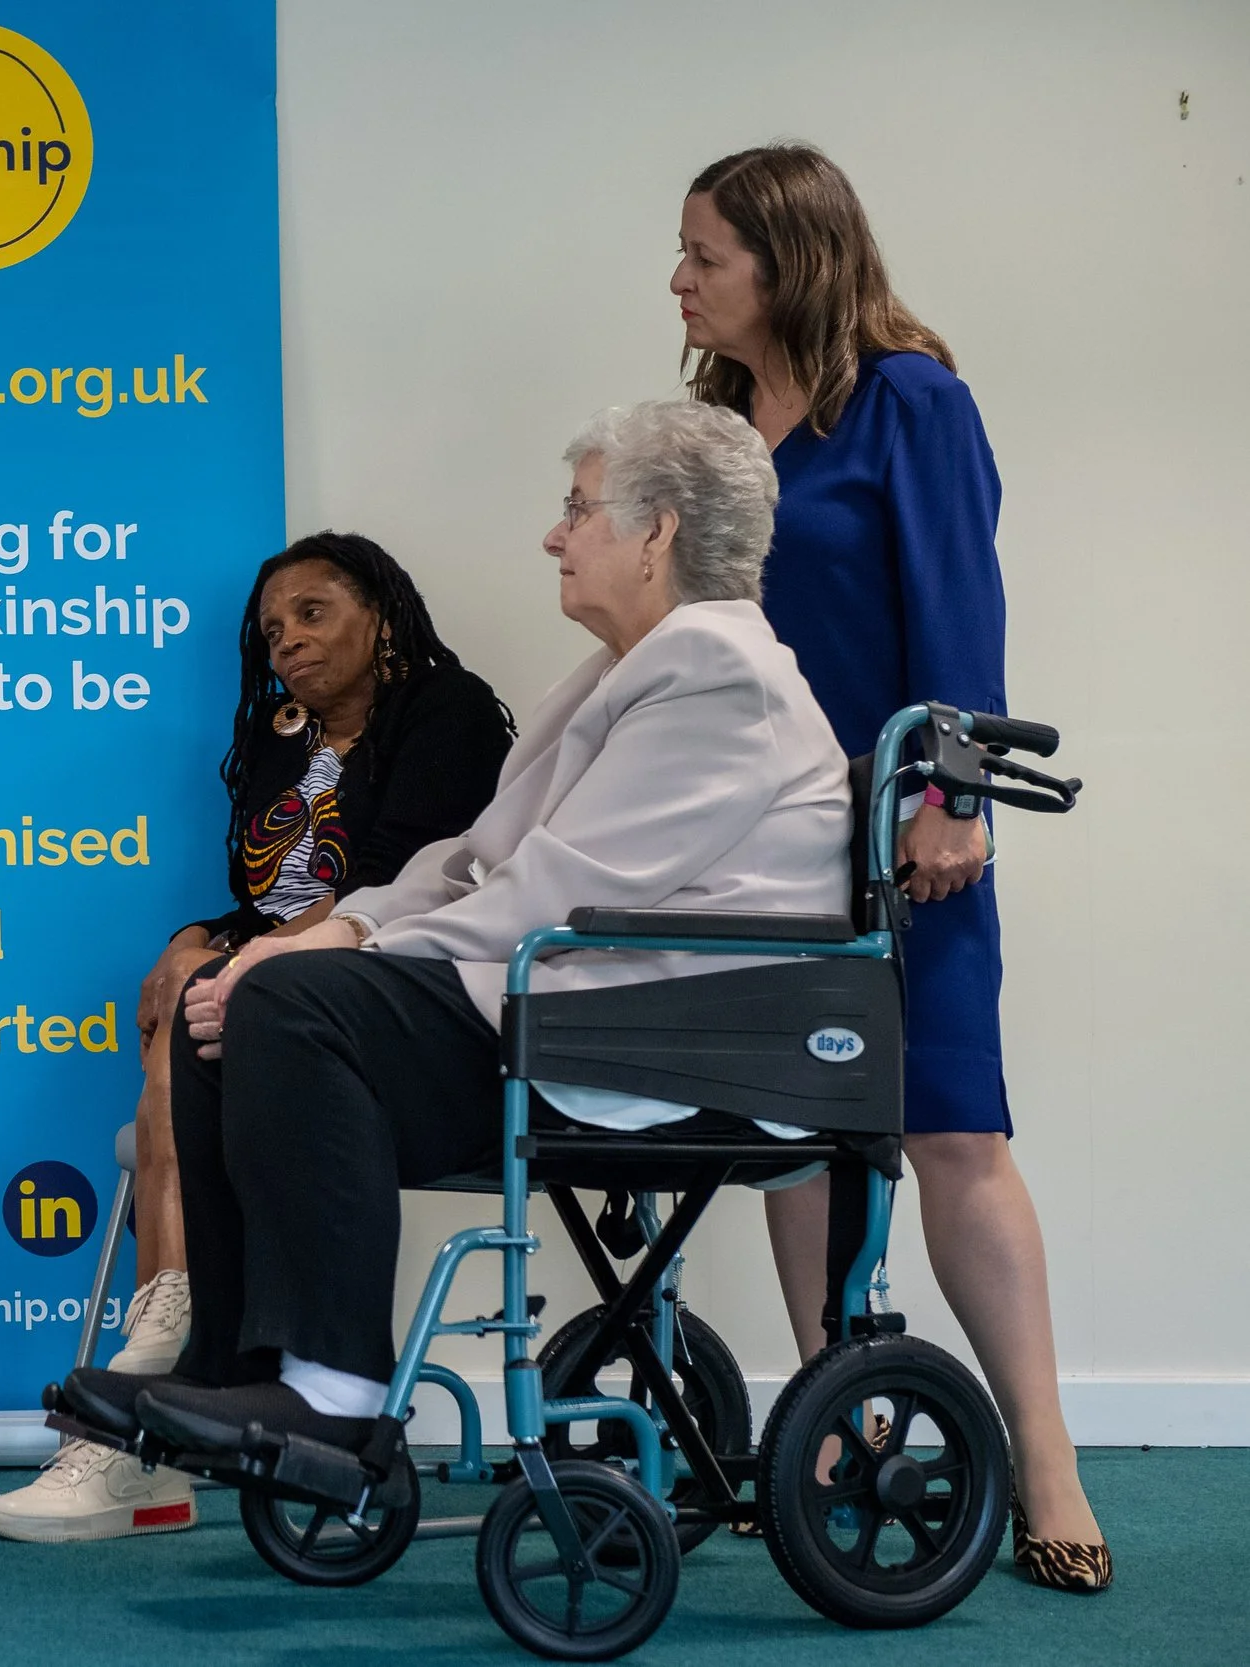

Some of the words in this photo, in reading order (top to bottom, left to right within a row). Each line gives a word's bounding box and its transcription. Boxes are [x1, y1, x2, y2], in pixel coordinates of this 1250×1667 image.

[48, 510, 138, 561] for
[72, 660, 151, 710] be
[817, 1034, 855, 1055] days
[19, 1179, 82, 1239] in
